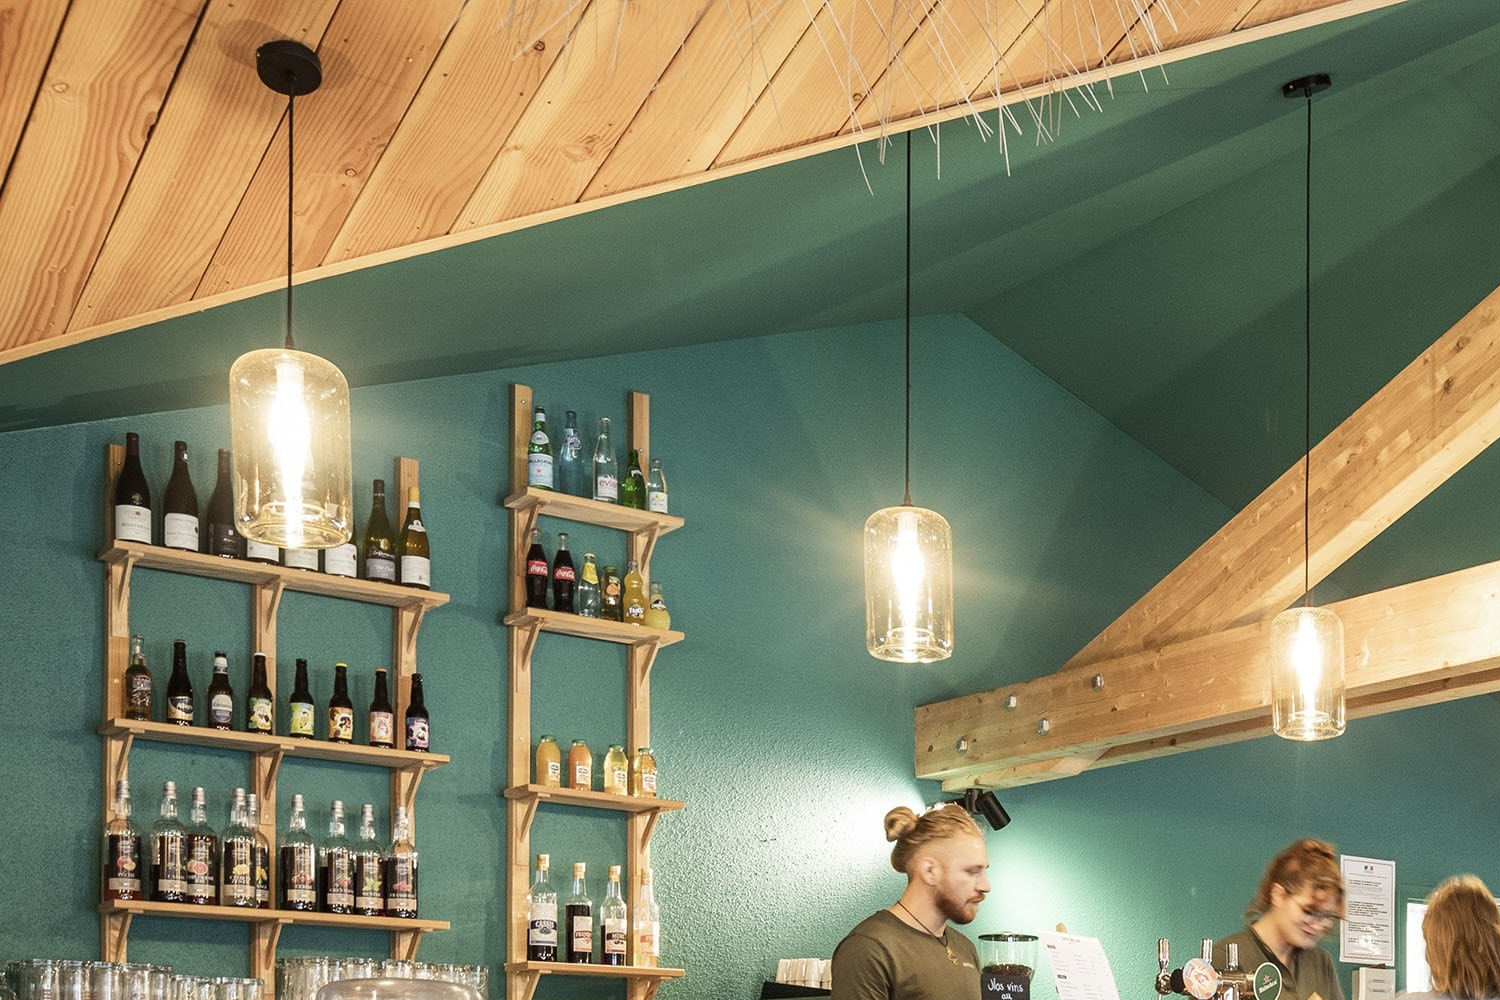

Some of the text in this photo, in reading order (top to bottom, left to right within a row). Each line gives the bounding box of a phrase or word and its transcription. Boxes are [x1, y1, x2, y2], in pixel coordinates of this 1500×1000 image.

[530, 564, 548, 575] Coca-Co
[556, 569, 575, 579] Coca-Co
[535, 920, 555, 929] CASSIS
[988, 978, 1024, 992] Nos vins
